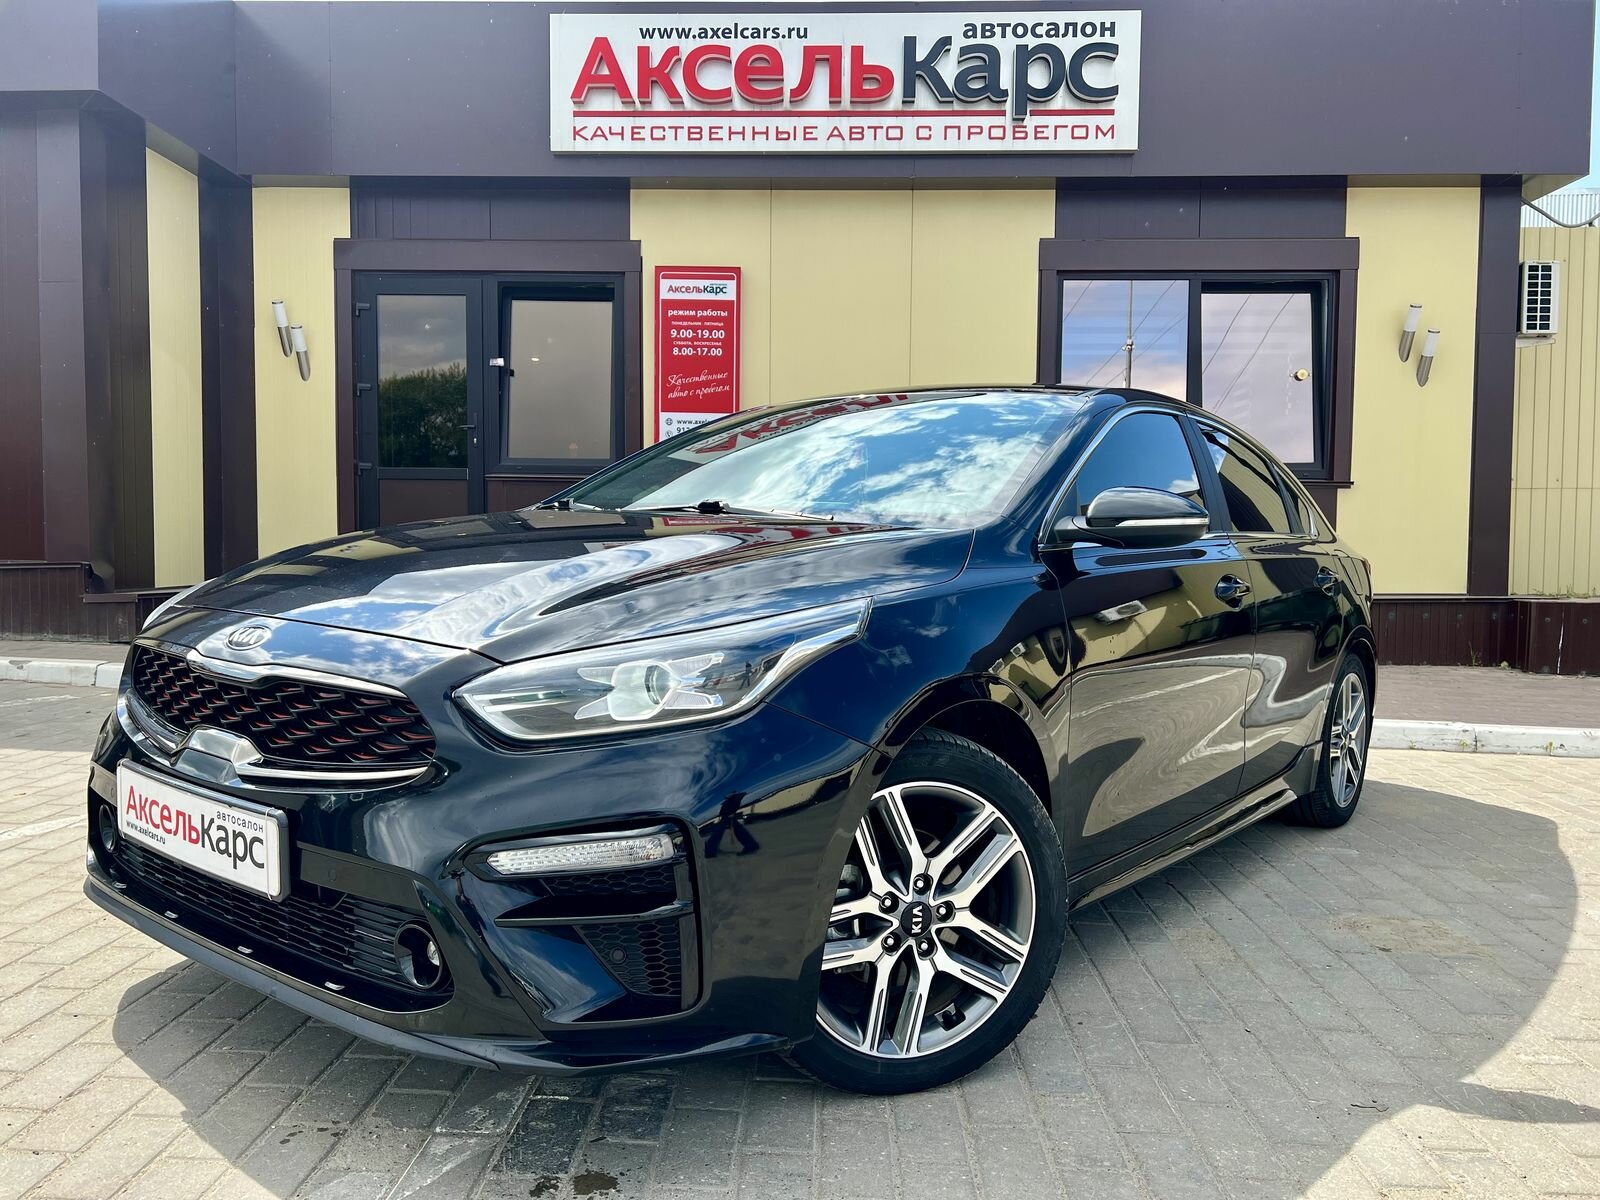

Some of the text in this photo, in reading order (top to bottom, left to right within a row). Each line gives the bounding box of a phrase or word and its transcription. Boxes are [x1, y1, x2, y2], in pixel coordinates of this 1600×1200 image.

[638, 23, 809, 41] www.axelcars.ru
[962, 21, 1117, 40] автосалон
[570, 35, 1120, 122] АксельКарс
[572, 125, 1116, 141] КАЧЕСТВЕННЫЕ АВТО С ПРОБЕГОМ
[667, 285, 727, 295] АксельКарс
[668, 309, 728, 317] режим работы
[670, 329, 725, 338] 9.00-19.00
[672, 347, 723, 356] 8.00-17.00
[667, 369, 728, 387] Качественные
[668, 386, 689, 399] авто
[695, 383, 730, 399] пробегом
[126, 785, 265, 870] АксельКарс
[216, 810, 264, 833] автосалон
[126, 820, 166, 845] www.axelcars.ru
[911, 905, 923, 934] KIA
